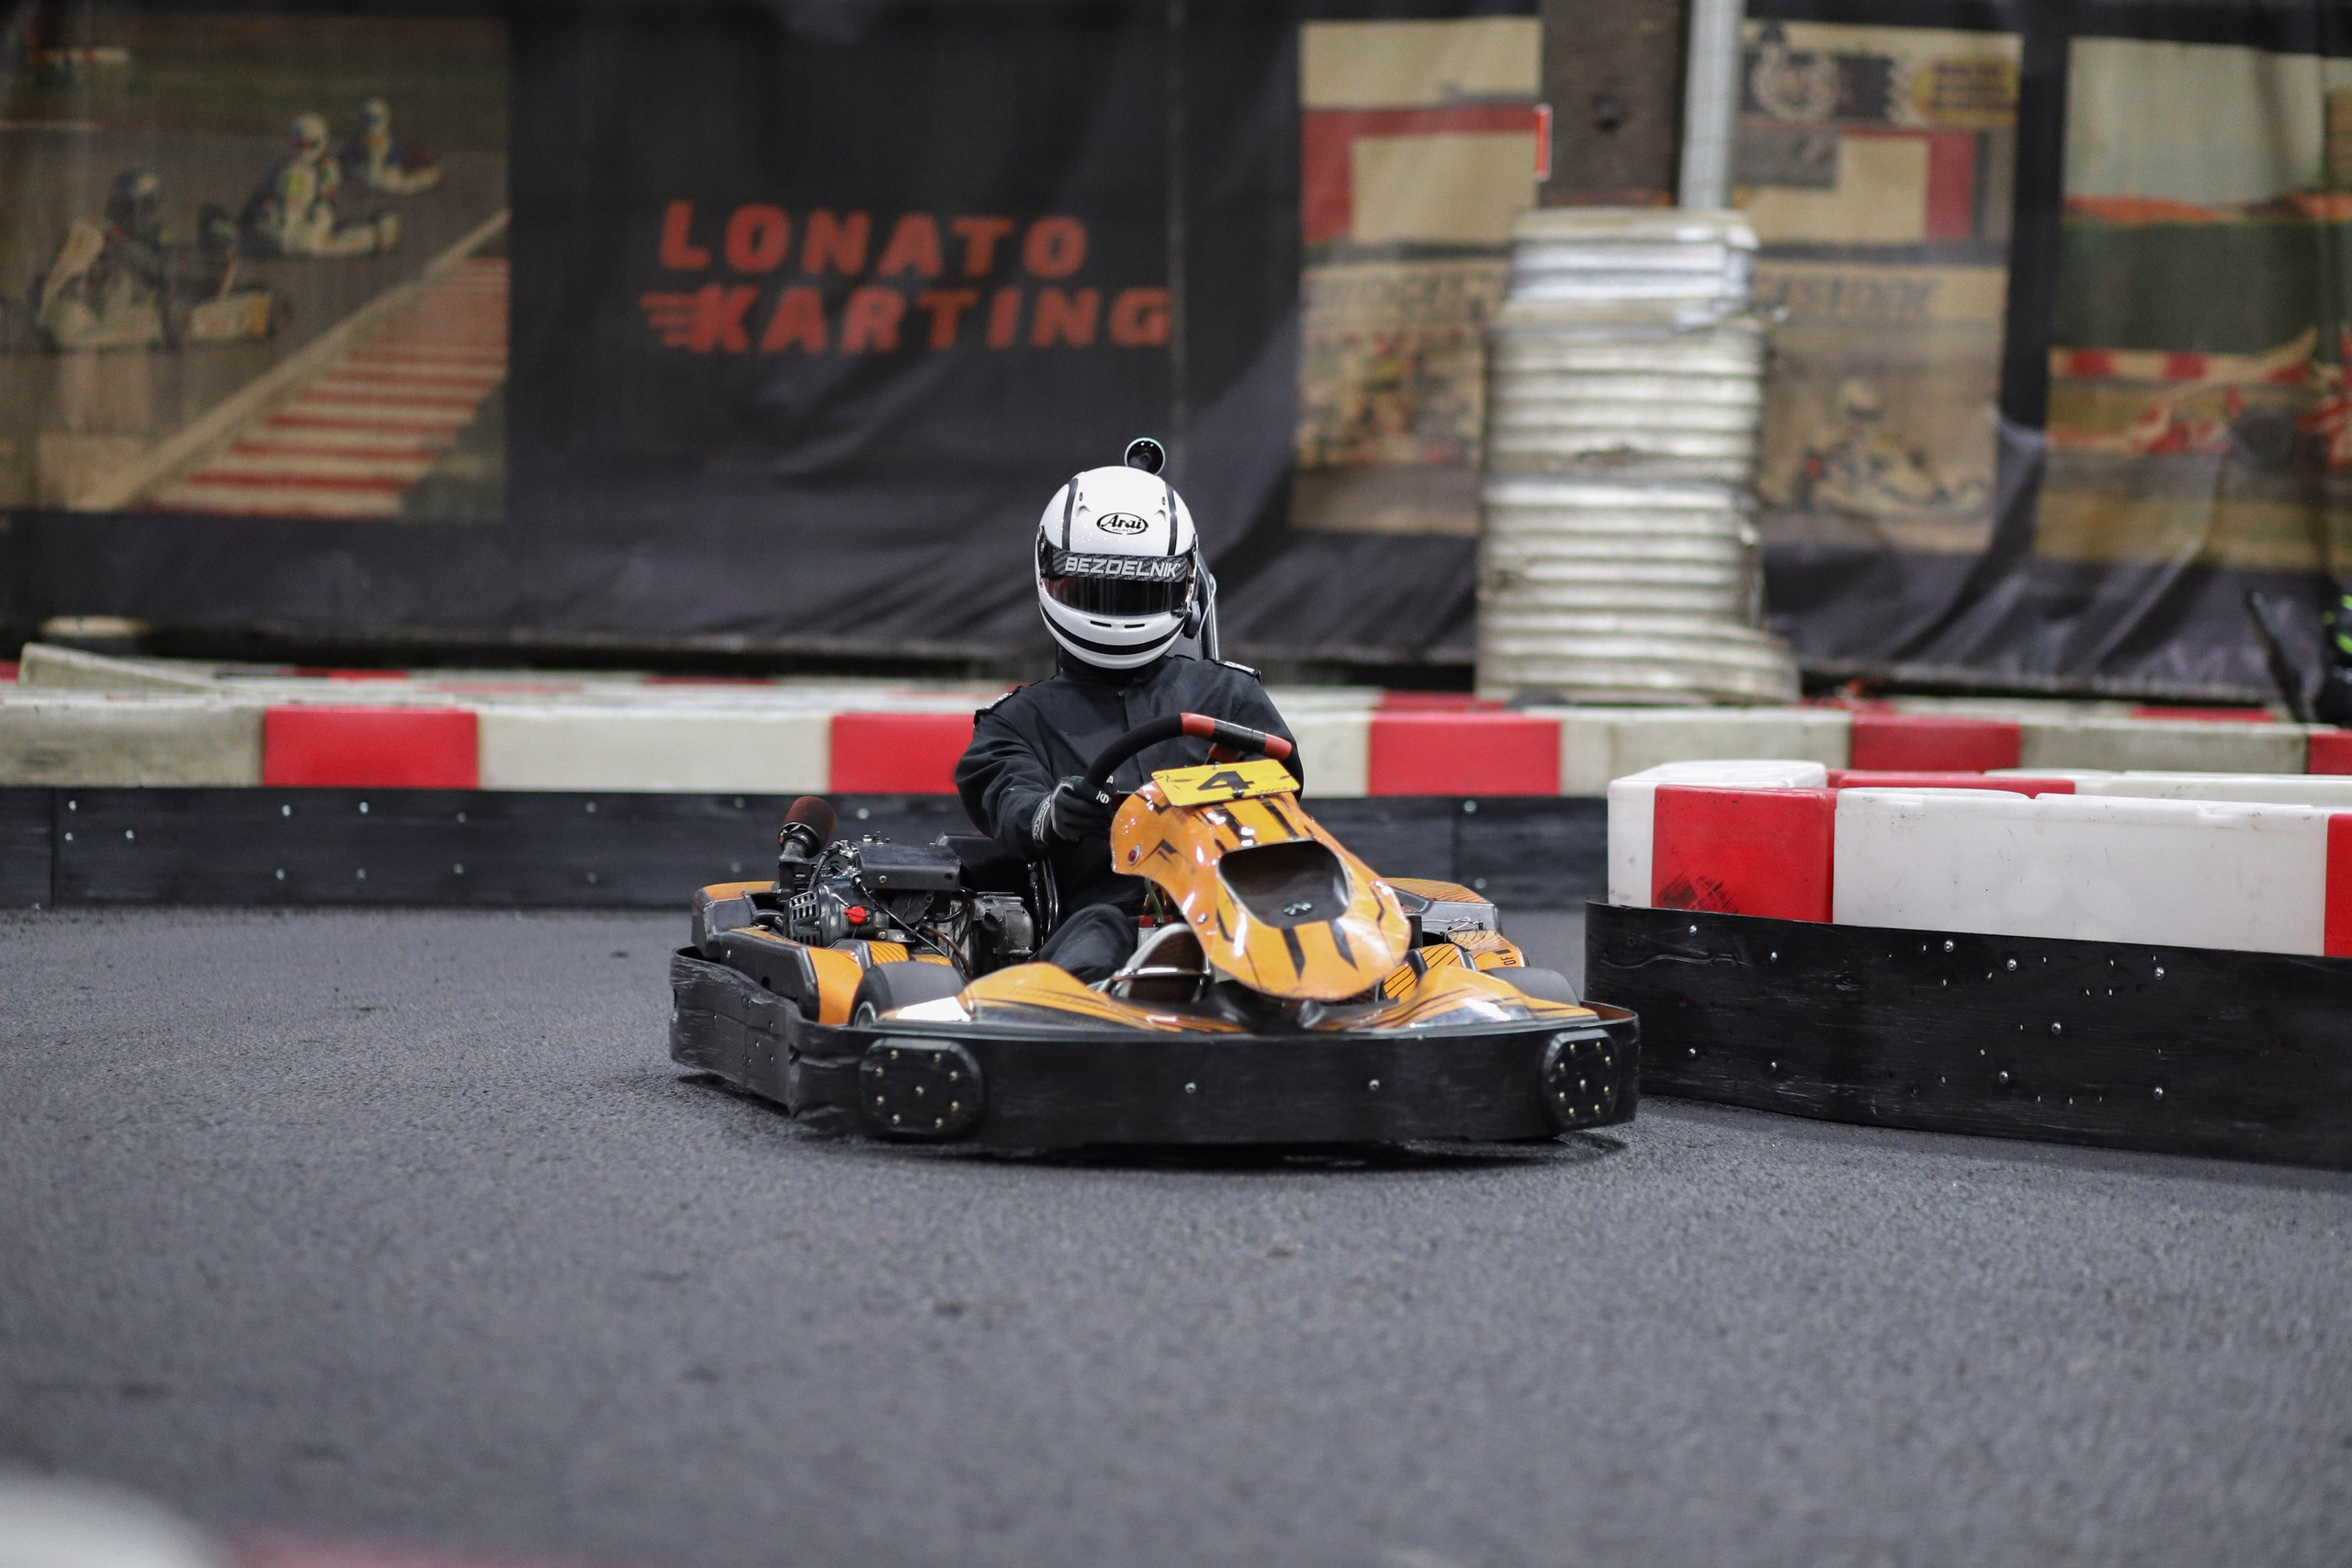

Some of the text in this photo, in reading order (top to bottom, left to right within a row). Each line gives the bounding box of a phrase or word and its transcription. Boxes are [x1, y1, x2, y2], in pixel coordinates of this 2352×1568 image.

[659, 199, 1088, 277] LONATO
[680, 284, 1171, 354] KARTING
[1100, 514, 1142, 529] Arai
[1065, 556, 1179, 578] BEZDELNIK
[1197, 770, 1255, 792] 4
